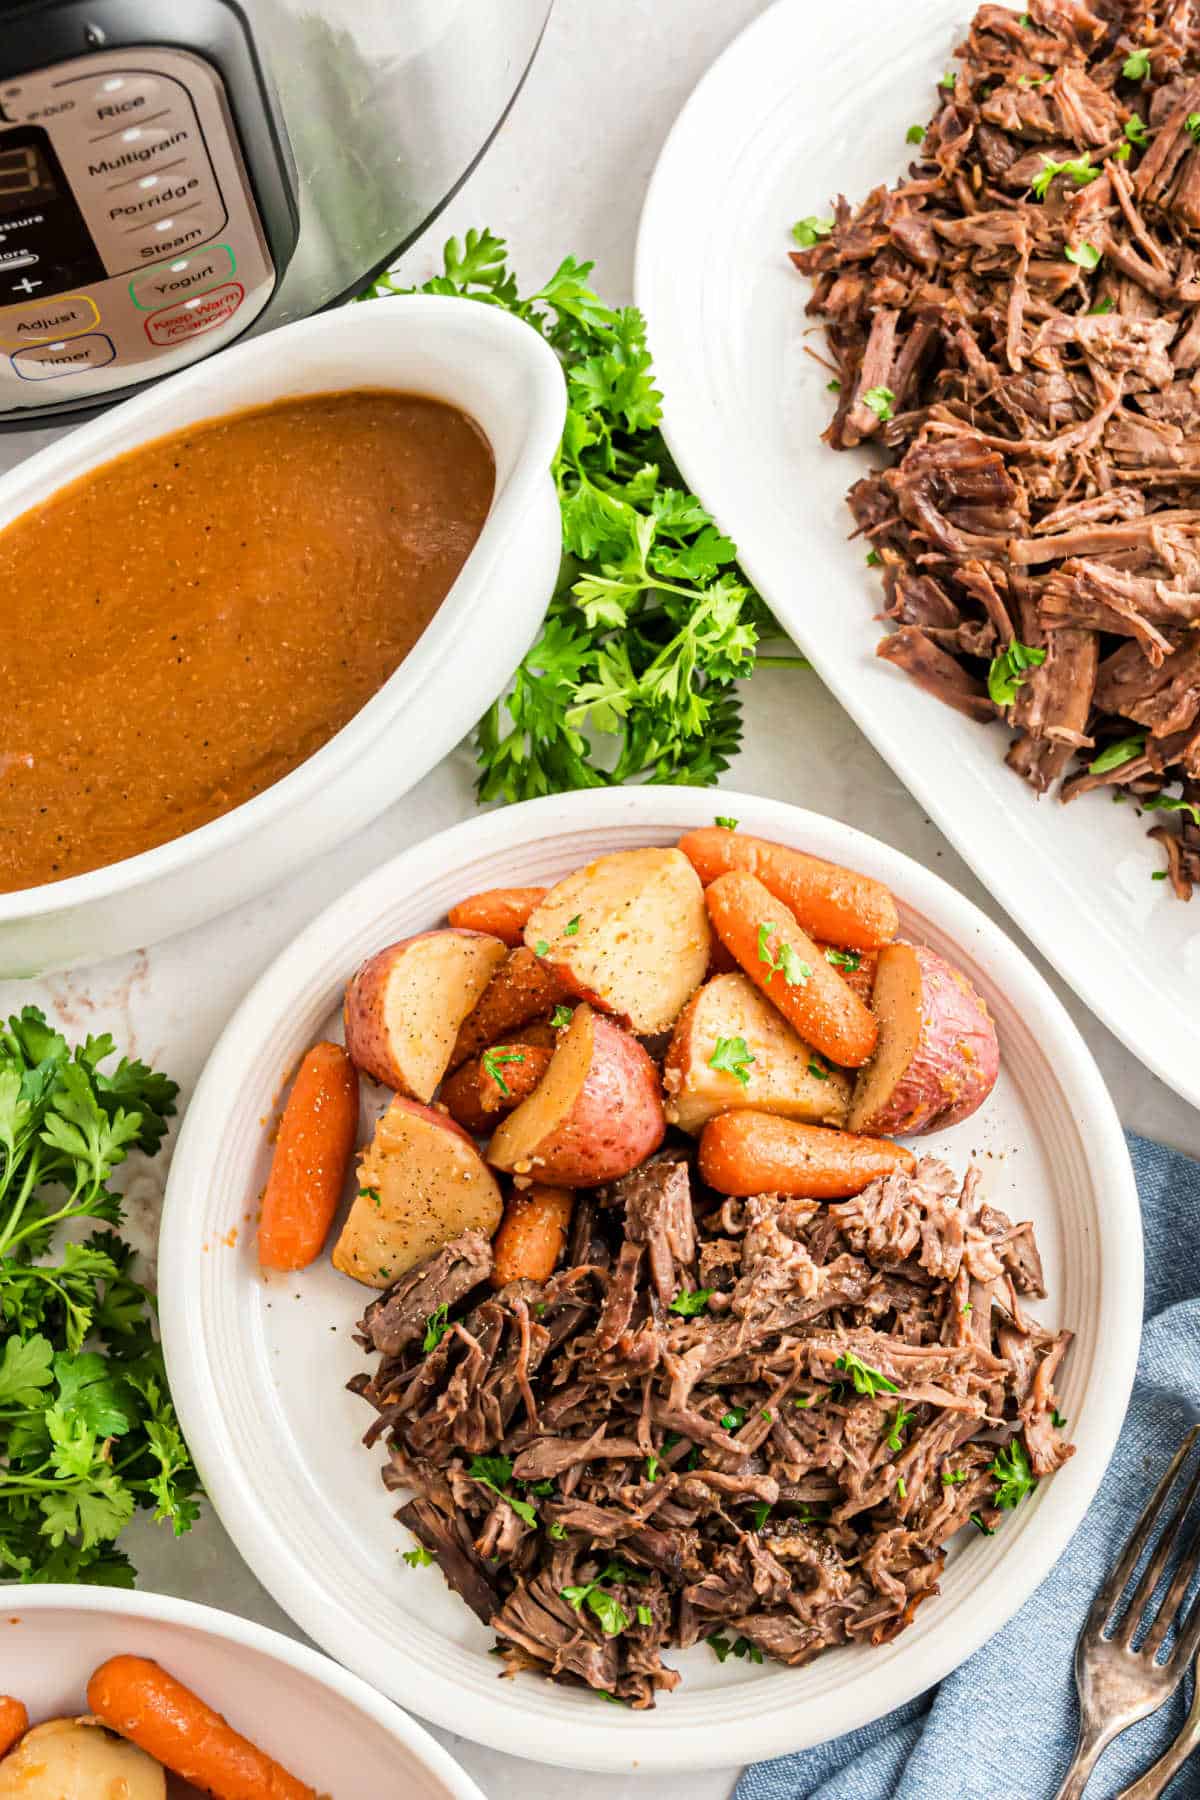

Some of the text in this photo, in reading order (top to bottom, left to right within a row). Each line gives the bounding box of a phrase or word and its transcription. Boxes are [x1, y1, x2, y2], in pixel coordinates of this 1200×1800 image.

[97, 96, 145, 120] Rice
[88, 131, 188, 176] Multigrain
[109, 179, 199, 220] Porridge
[140, 229, 202, 258] Steam
[155, 266, 214, 294] Yogurt
[17, 311, 77, 332] Adjust
[153, 291, 239, 331] Keep Warm
[38, 350, 90, 367] Timer
